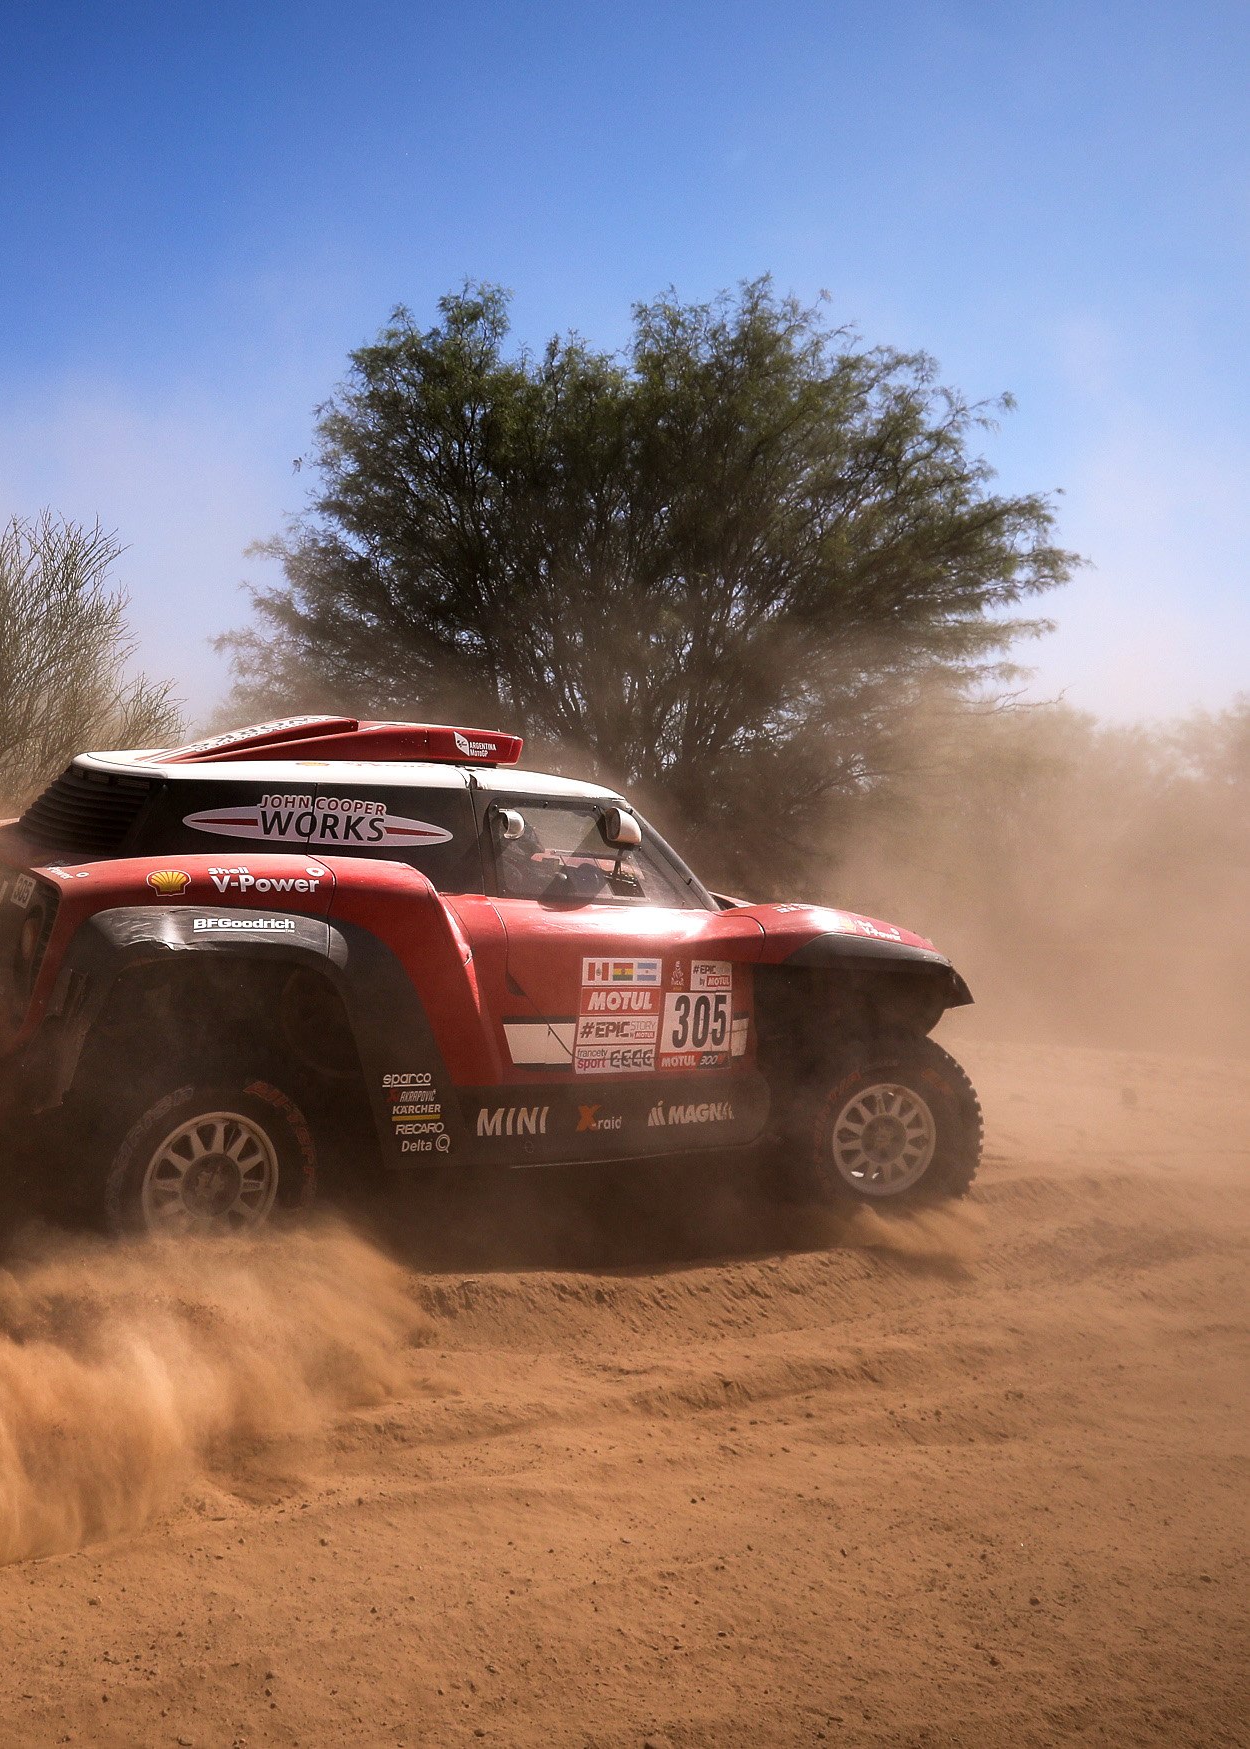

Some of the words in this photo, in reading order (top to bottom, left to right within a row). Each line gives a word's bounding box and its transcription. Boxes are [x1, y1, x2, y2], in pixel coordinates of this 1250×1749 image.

[469, 741, 497, 751] ARGENTINA
[259, 795, 311, 809] JOHN
[315, 798, 385, 816] COOPER
[260, 810, 385, 842] WORKS
[207, 866, 250, 875] Shell
[210, 874, 320, 893] V-Power
[193, 918, 295, 929] BFGoodrich
[707, 976, 730, 986] MOTUL
[587, 991, 653, 1011] MOTUL
[671, 994, 728, 1049] 305
[580, 1021, 631, 1039] #EPIC
[577, 1057, 607, 1069] sport
[661, 1055, 696, 1068] MOTUL
[382, 1073, 432, 1088] sparco
[476, 1106, 550, 1136] MINI
[395, 1122, 445, 1135] RECARO
[401, 1139, 432, 1152] Delta
